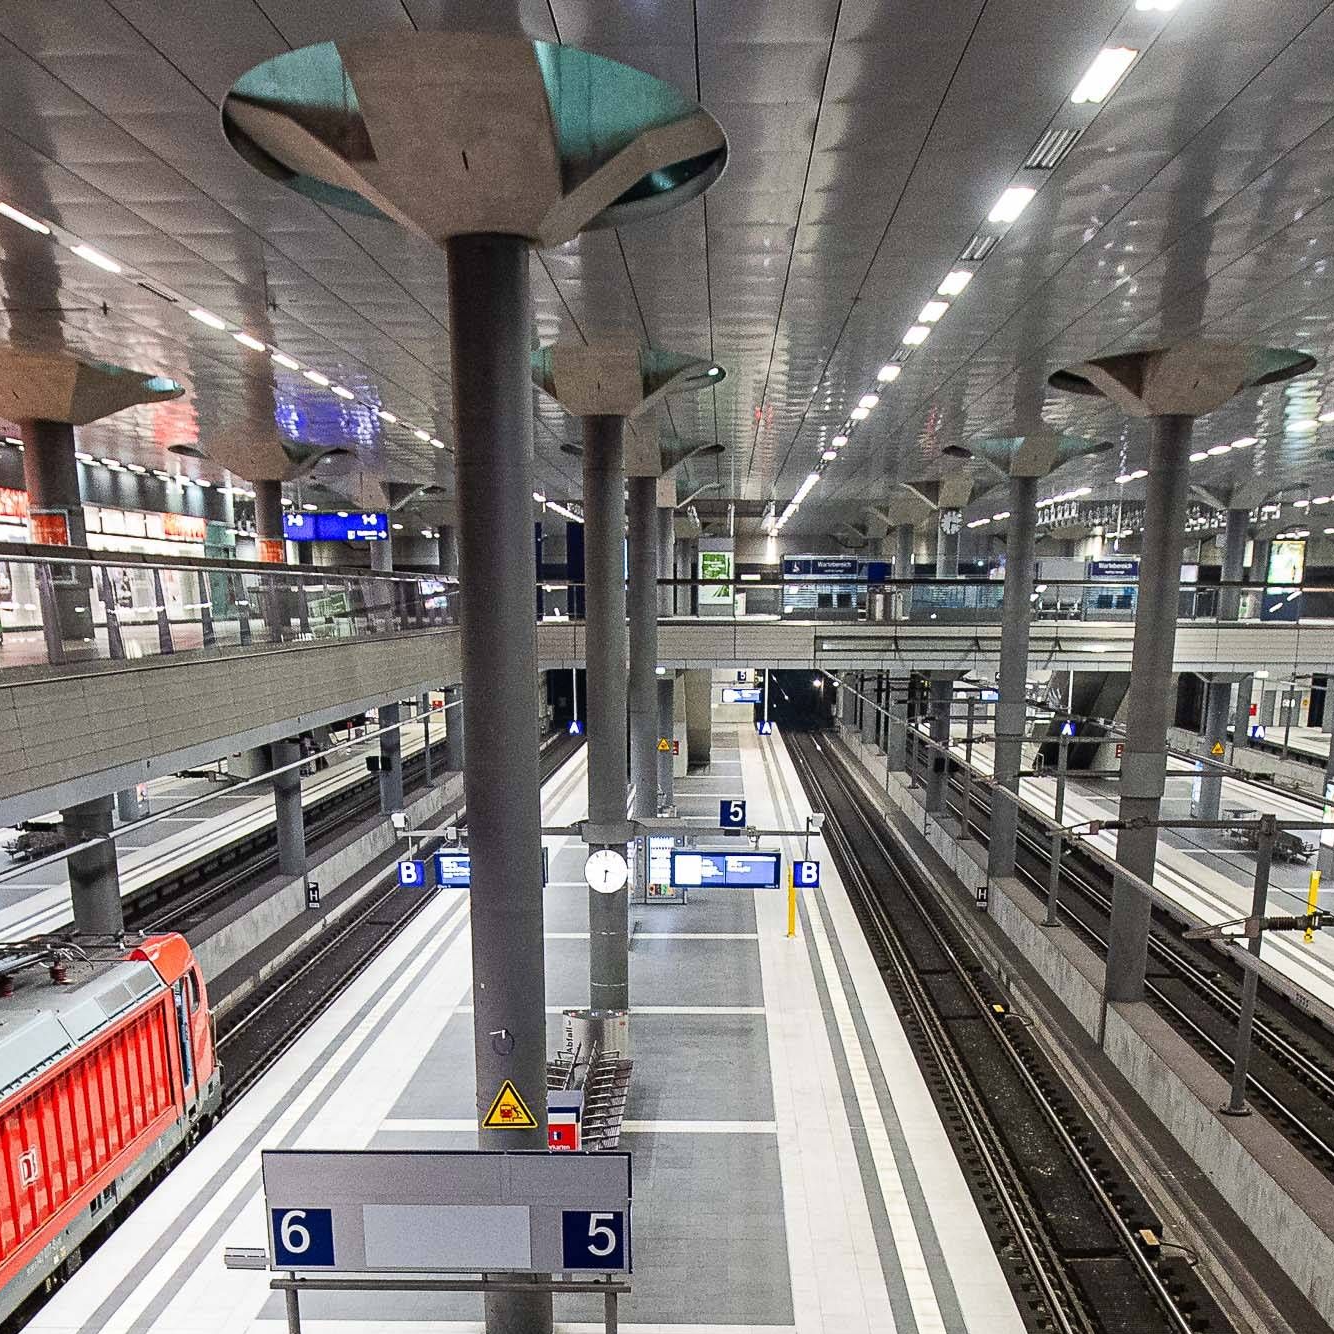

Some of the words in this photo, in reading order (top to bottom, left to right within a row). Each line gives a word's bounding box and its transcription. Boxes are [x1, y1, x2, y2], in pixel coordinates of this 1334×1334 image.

[569, 721, 580, 734] A
[761, 721, 772, 734] A
[1062, 722, 1074, 736] A
[729, 801, 743, 822] 5
[400, 861, 418, 884] B
[801, 862, 818, 884] B
[309, 890, 318, 901] H
[978, 888, 987, 900] H
[565, 1026, 574, 1053] Abfall
[280, 1209, 311, 1254] 6
[587, 1212, 616, 1256] 5
